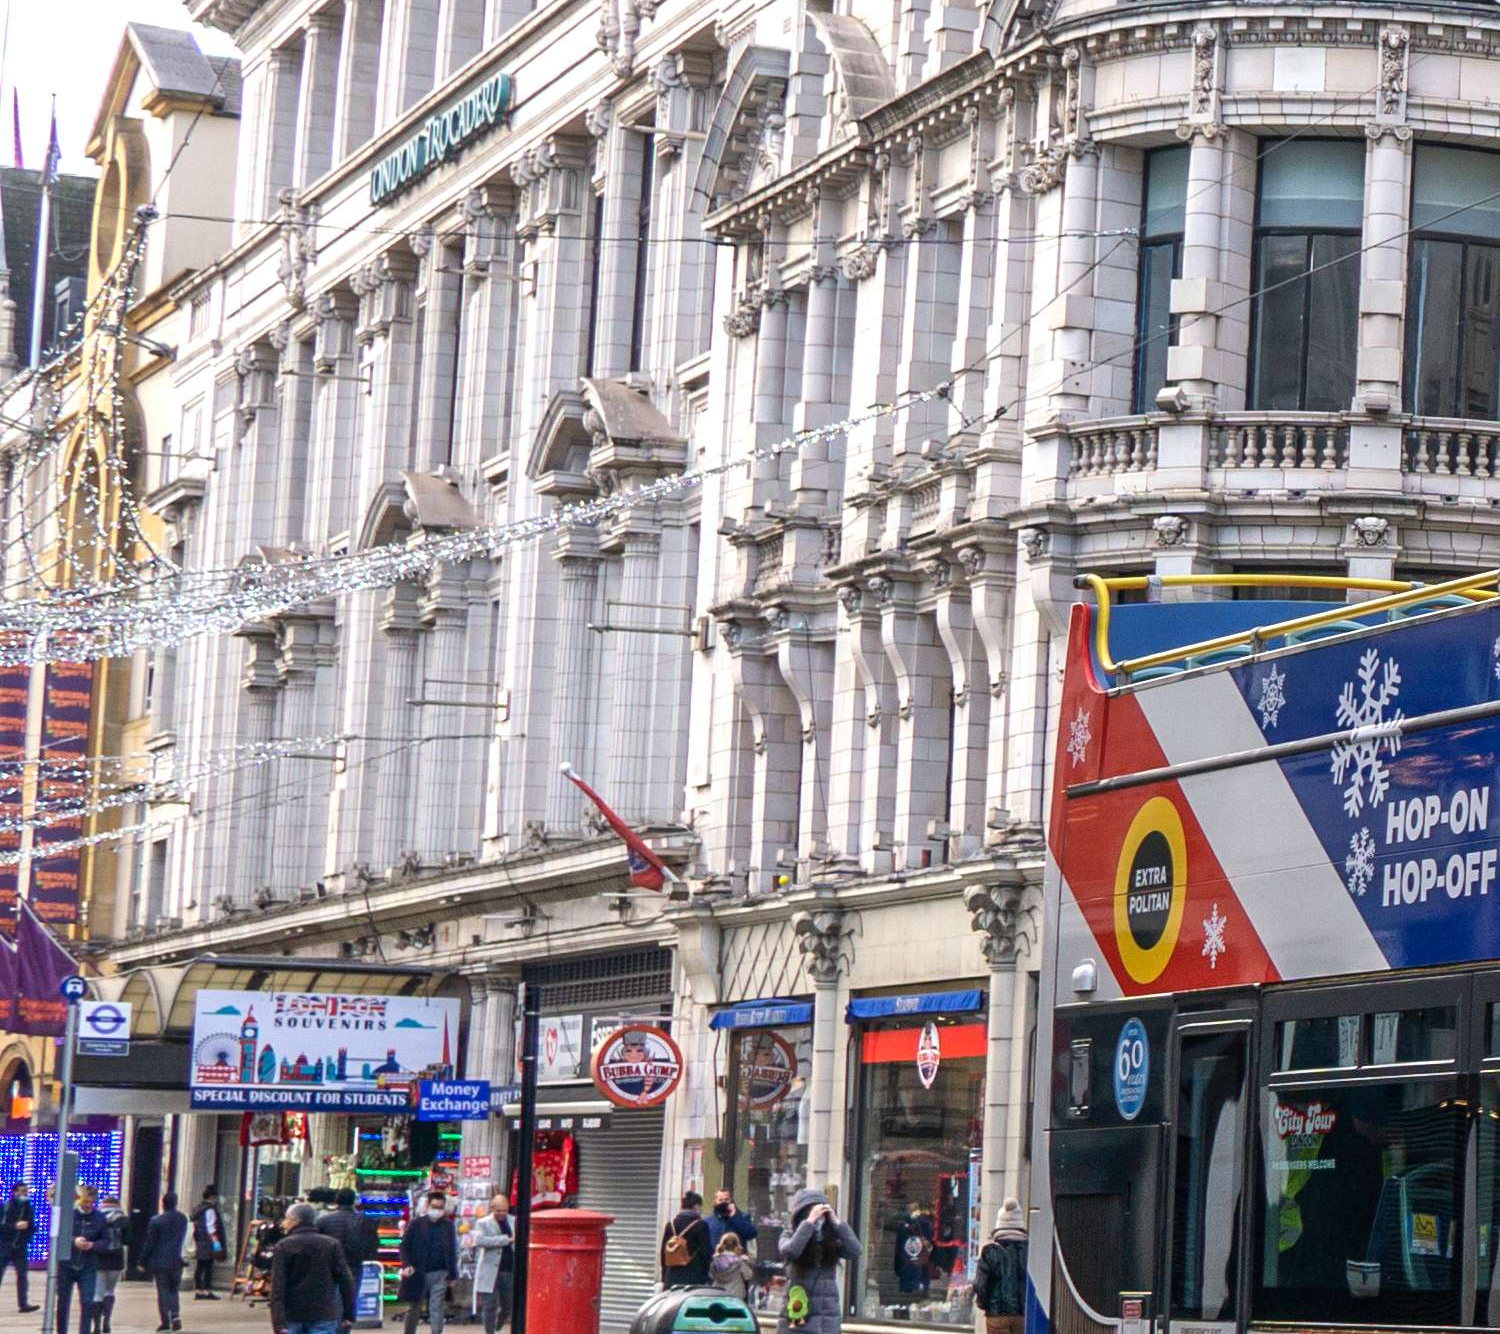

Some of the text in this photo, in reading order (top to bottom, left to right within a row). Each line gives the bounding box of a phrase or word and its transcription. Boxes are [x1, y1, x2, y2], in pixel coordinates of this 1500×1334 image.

[421, 71, 505, 165] TROCADERO
[1385, 786, 1491, 846] HOP-ON
[1135, 866, 1167, 890] EXTRA
[1381, 848, 1498, 909] HOP-OFF
[1129, 890, 1170, 916] POLITAN
[275, 995, 389, 1017] LONDON
[274, 1017, 387, 1031] SOUVENIRS
[1119, 1038, 1144, 1081] 60
[603, 1066, 677, 1080] BUBBA GUMP
[194, 1089, 407, 1106] SPECIAL DISCOUNT FOR STUDENTS
[431, 1082, 480, 1098] Money
[421, 1098, 489, 1114] Exchange
